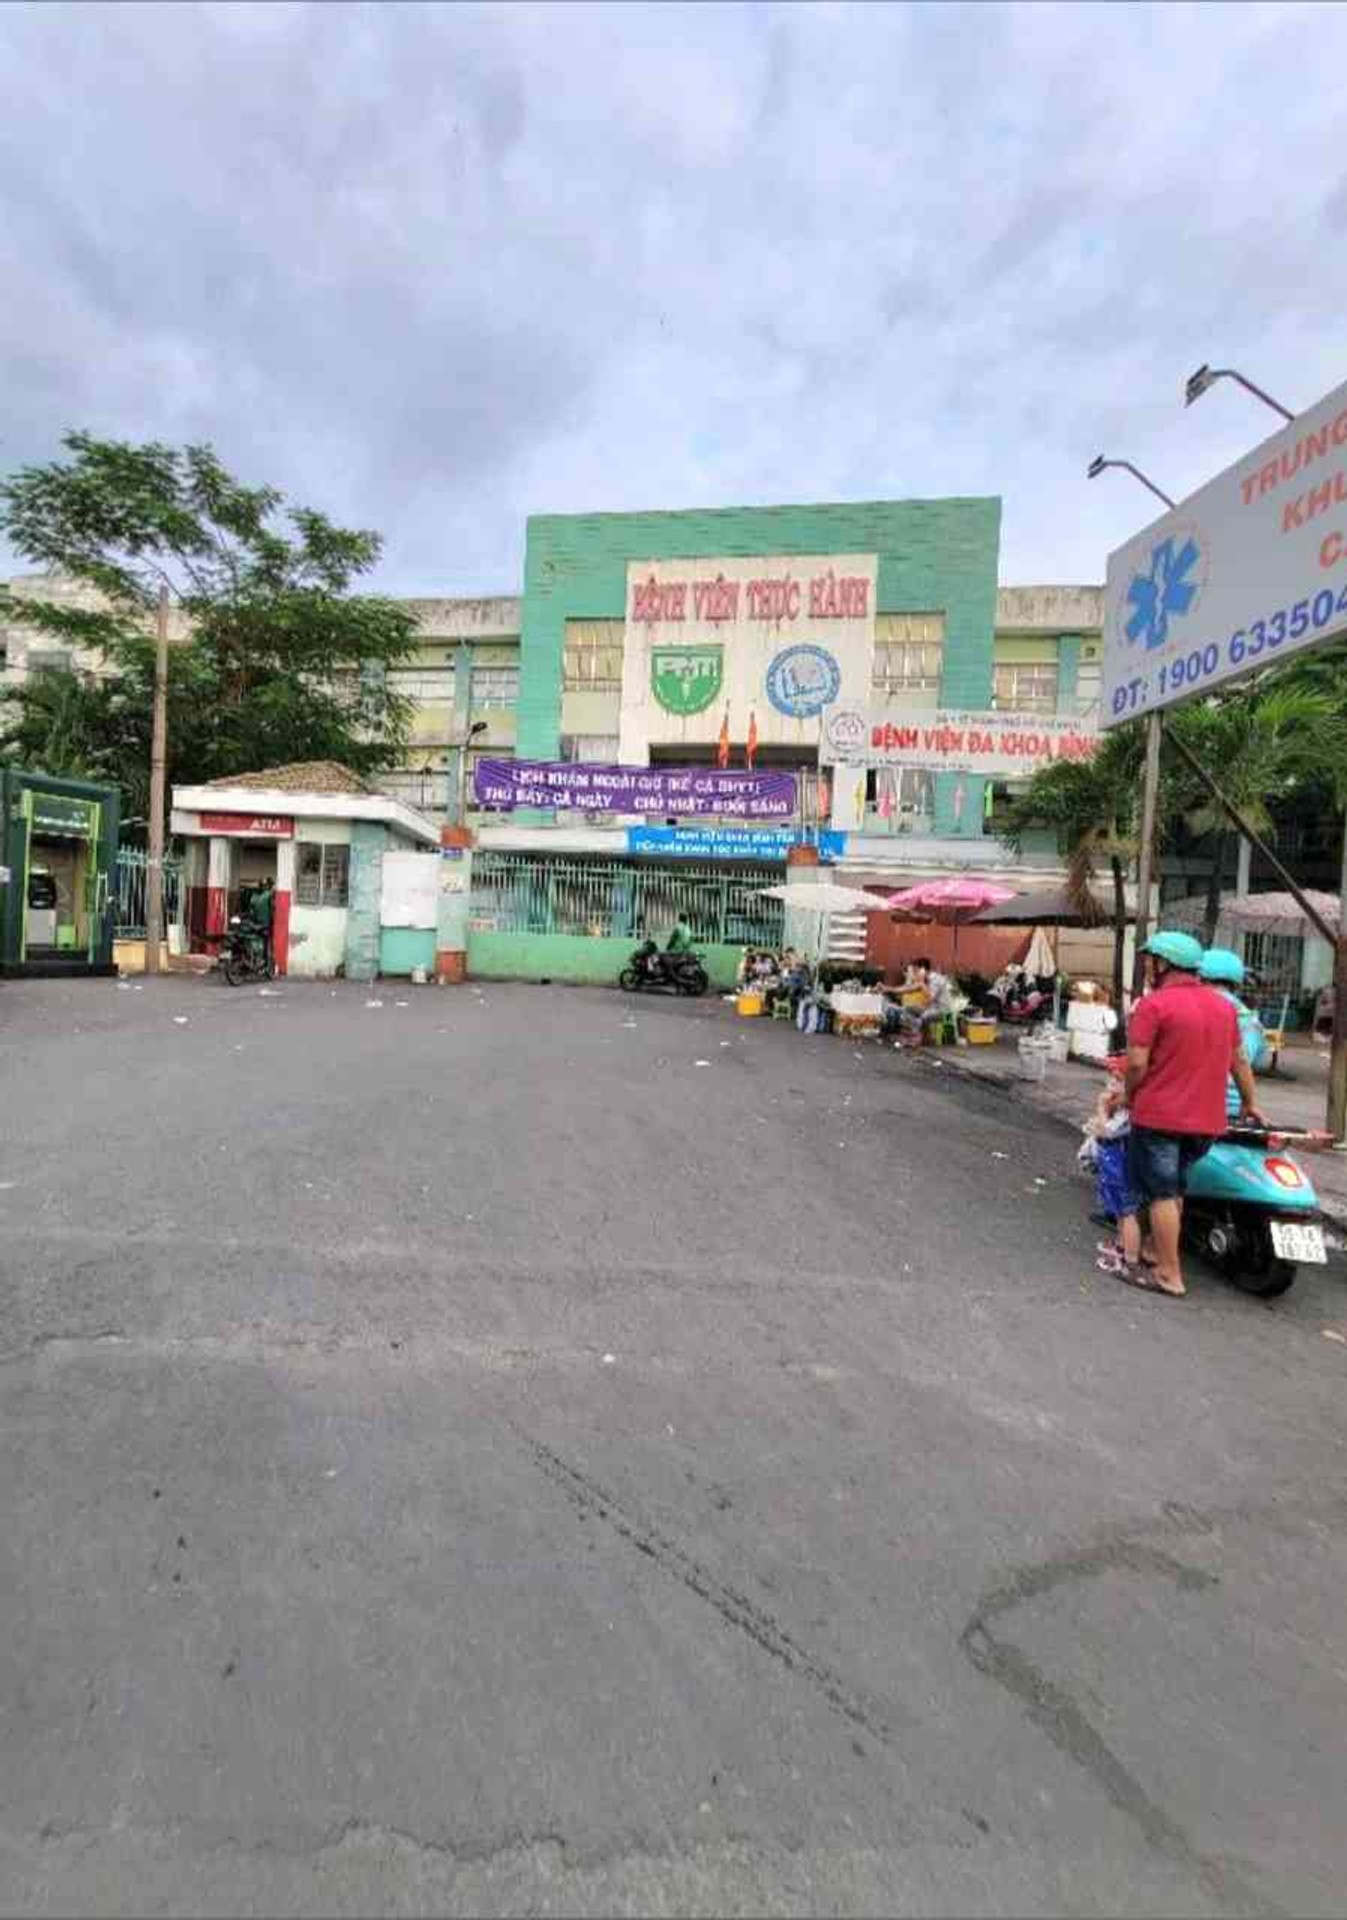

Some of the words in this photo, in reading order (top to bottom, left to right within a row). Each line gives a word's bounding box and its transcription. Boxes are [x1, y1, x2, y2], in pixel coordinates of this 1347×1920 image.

[693, 573, 740, 627] VIỆN
[808, 569, 870, 618] HÀNH
[1112, 677, 1148, 716] ĐT:
[1158, 643, 1219, 698] 1900
[872, 721, 918, 752] BỆNH
[924, 725, 963, 756] VIỆN
[968, 730, 994, 755] ĐA
[1000, 732, 1053, 760] KHOA
